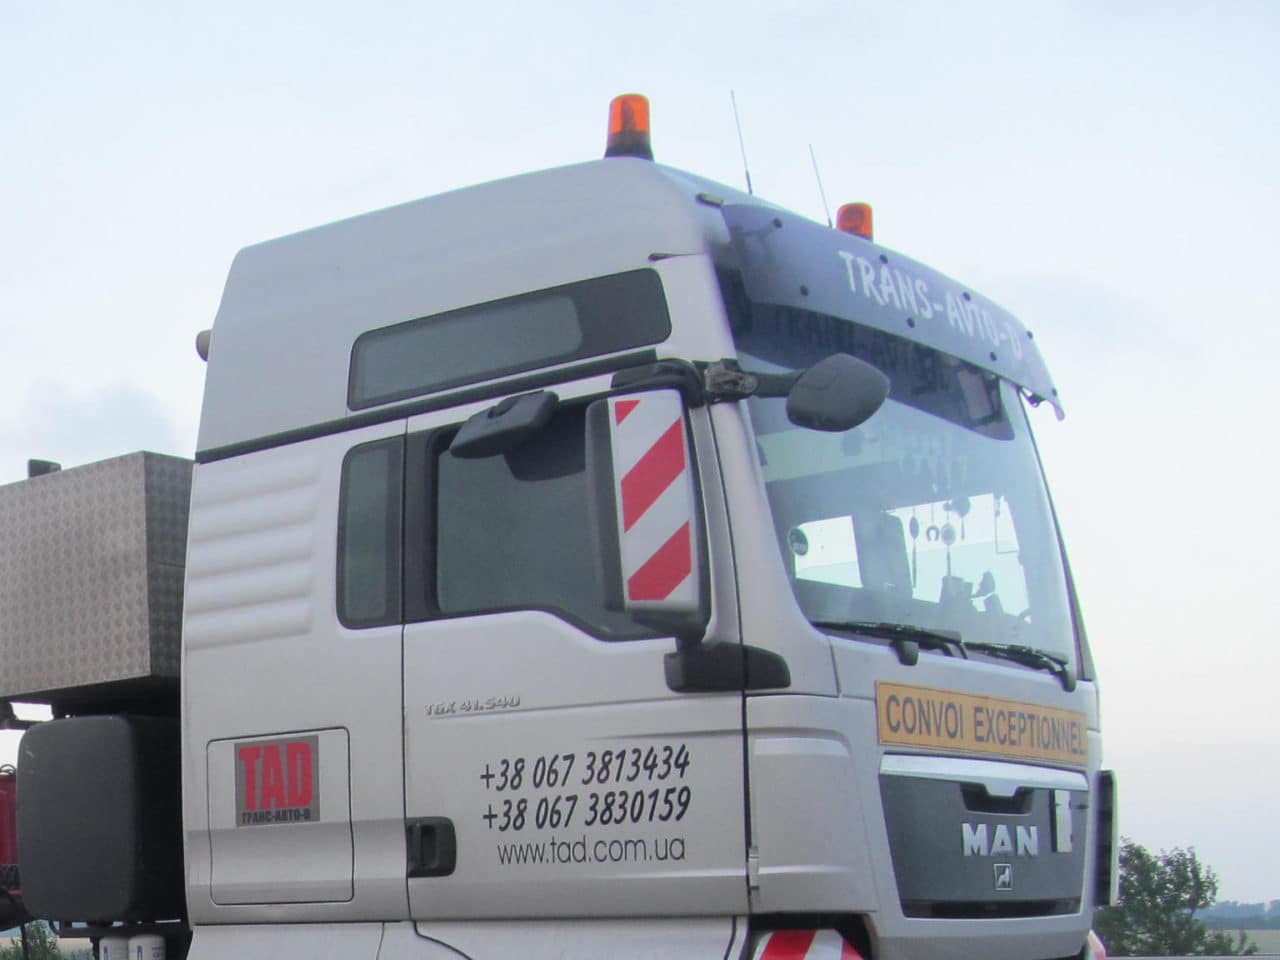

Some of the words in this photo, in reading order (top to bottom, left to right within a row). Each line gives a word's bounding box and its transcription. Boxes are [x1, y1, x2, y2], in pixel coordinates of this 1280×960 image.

[460, 696, 521, 712] 41.540
[886, 694, 964, 740] CONVOI
[973, 706, 1087, 755] EXCEPTIONNEL
[239, 742, 314, 811] TAD
[480, 757, 525, 791] +38
[532, 753, 576, 789] 067
[581, 744, 691, 785] 3813434
[483, 798, 528, 831] +38
[535, 795, 579, 829] 067
[584, 786, 692, 826] 3830159
[497, 835, 686, 865] www.tad.com.ua
[961, 823, 1039, 857] MAN
